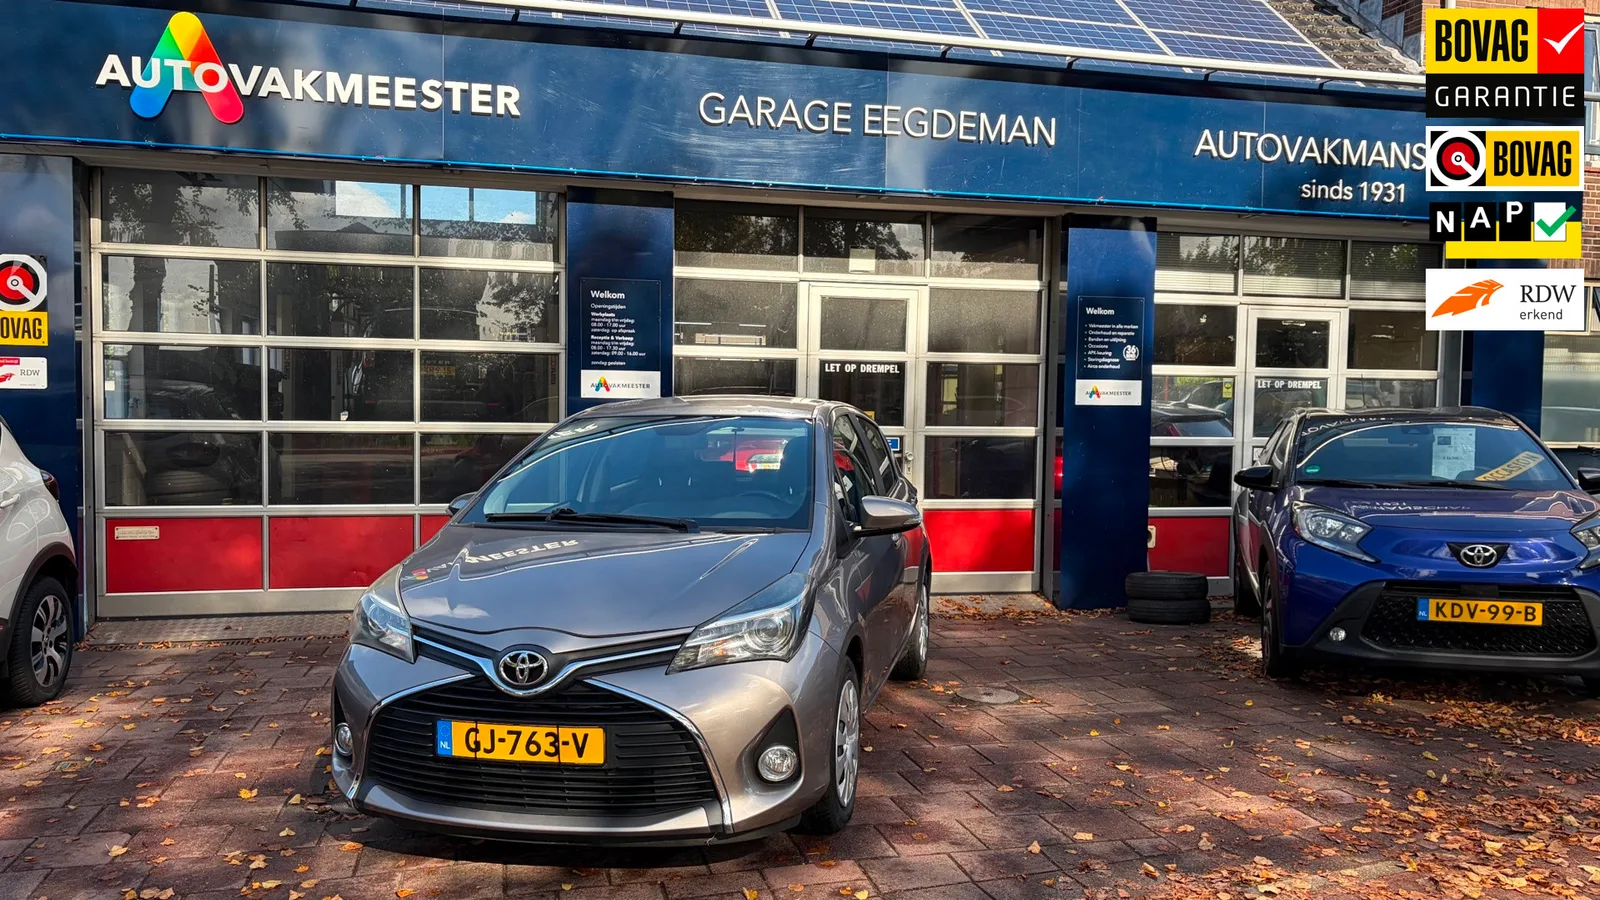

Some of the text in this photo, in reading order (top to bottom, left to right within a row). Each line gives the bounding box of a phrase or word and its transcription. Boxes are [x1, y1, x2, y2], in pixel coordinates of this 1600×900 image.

[96, 54, 520, 117] AUTOVAKMEESTER
[699, 92, 1056, 146] GARAGE EEGDEMAN
[1301, 178, 1406, 203] sinds 1931
[590, 290, 625, 299] Welkom
[1085, 307, 1115, 315] Welkom
[0, 316, 42, 340] OVAG
[1126, 344, 1137, 354] 36
[825, 363, 900, 374] LET OP DREMPEL
[1257, 380, 1321, 389] LET OP DREMPEL
[1435, 601, 1537, 622] KDV-99-B
[440, 727, 589, 759] NL GJ-763-V
